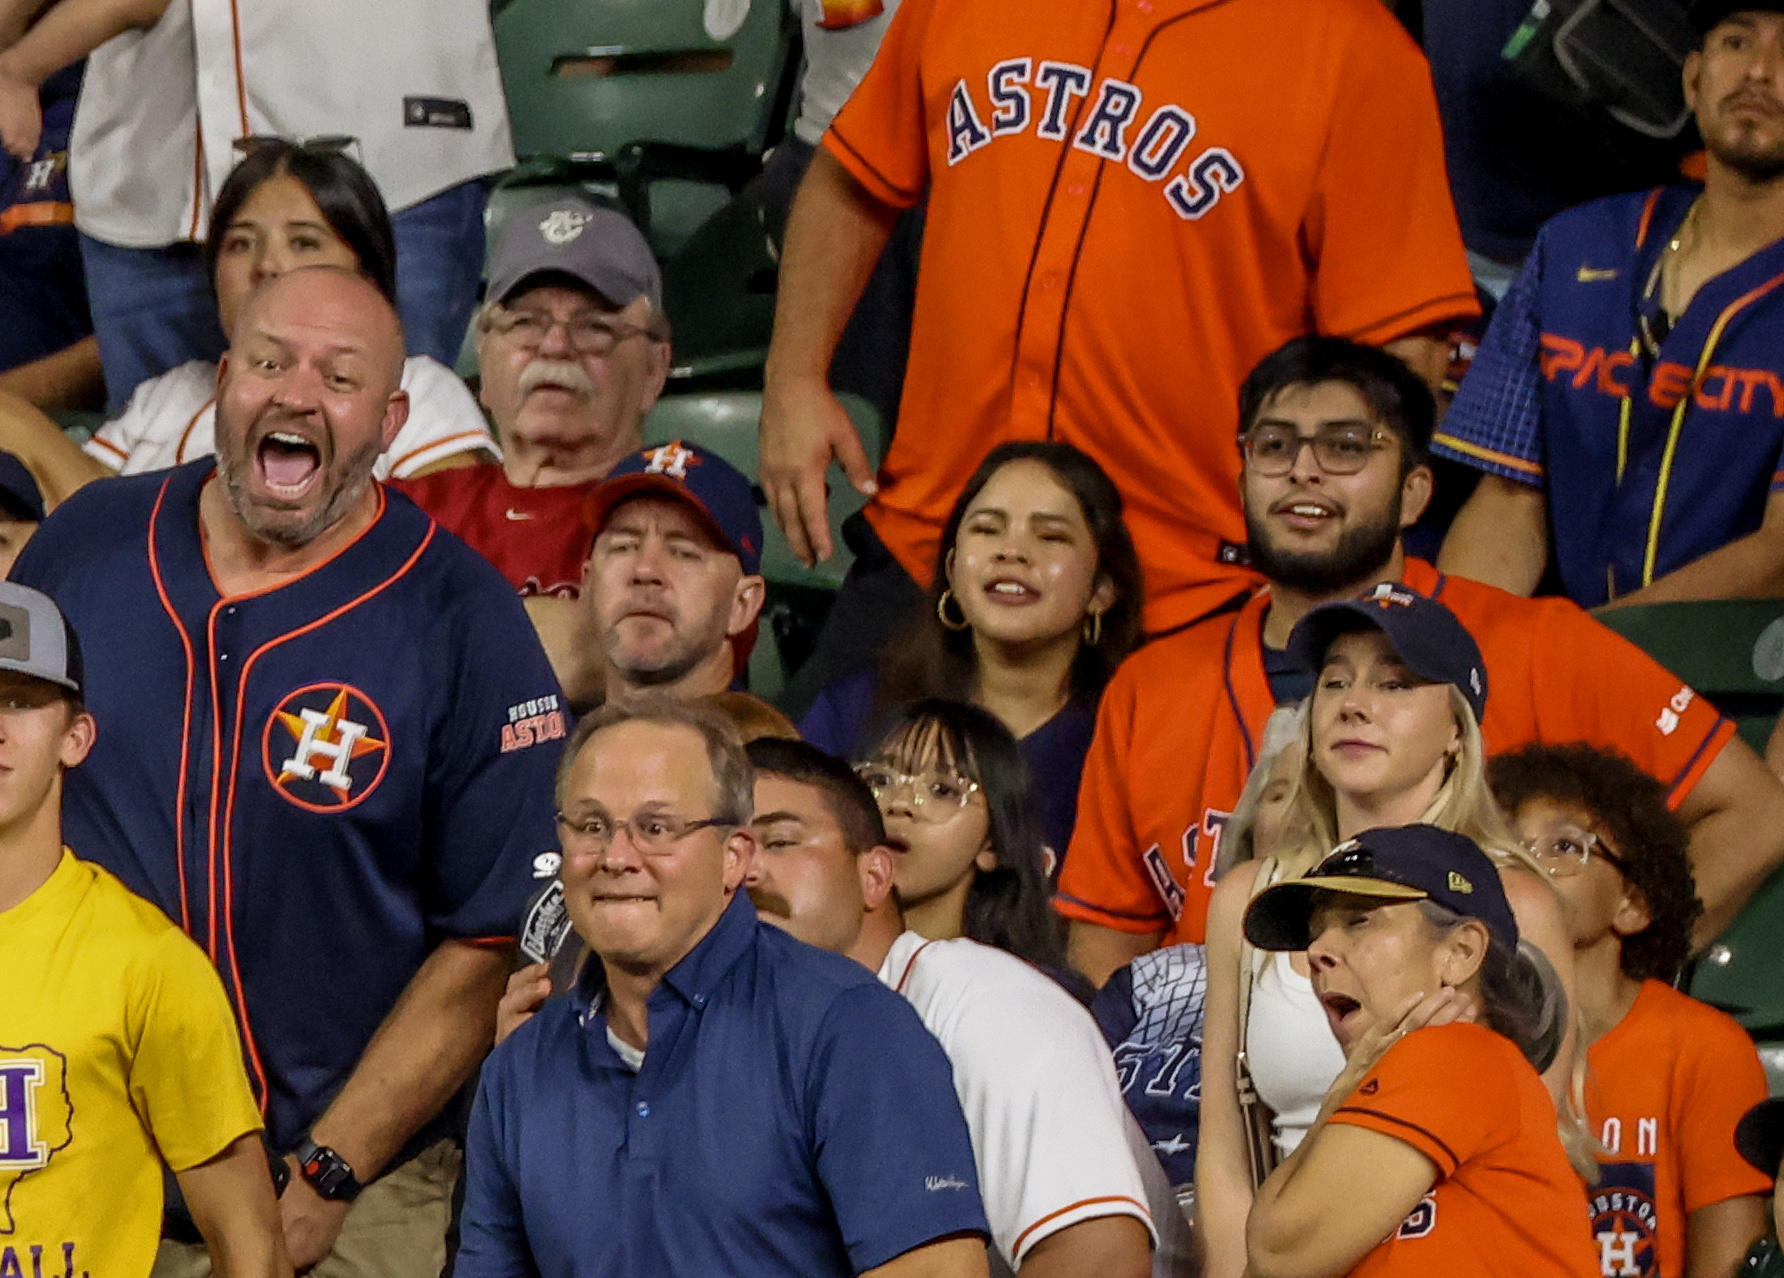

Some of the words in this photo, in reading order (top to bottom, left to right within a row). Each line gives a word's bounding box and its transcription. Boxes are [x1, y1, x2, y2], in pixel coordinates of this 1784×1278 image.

[946, 57, 1244, 219] ASTROS
[282, 707, 369, 790] H
[1602, 1117, 1658, 1156] ON
